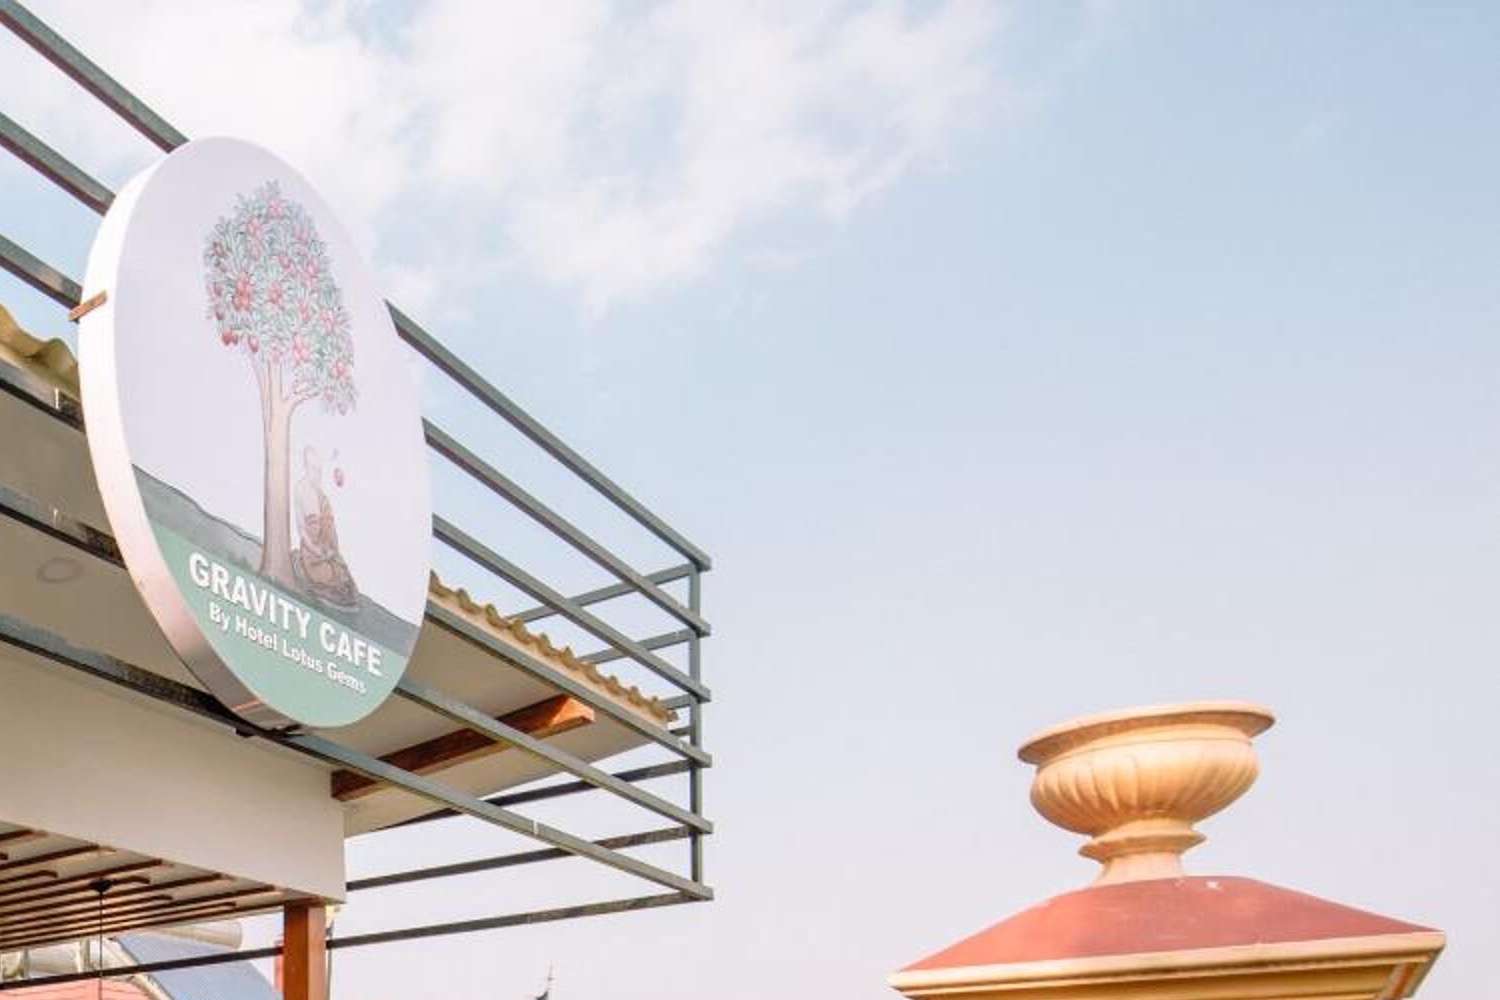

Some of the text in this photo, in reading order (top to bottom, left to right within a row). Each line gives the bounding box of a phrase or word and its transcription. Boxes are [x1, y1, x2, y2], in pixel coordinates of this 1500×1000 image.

[190, 552, 383, 677] GRAVITY CAFE
[210, 602, 367, 694] By Hotel Lotus Gems
